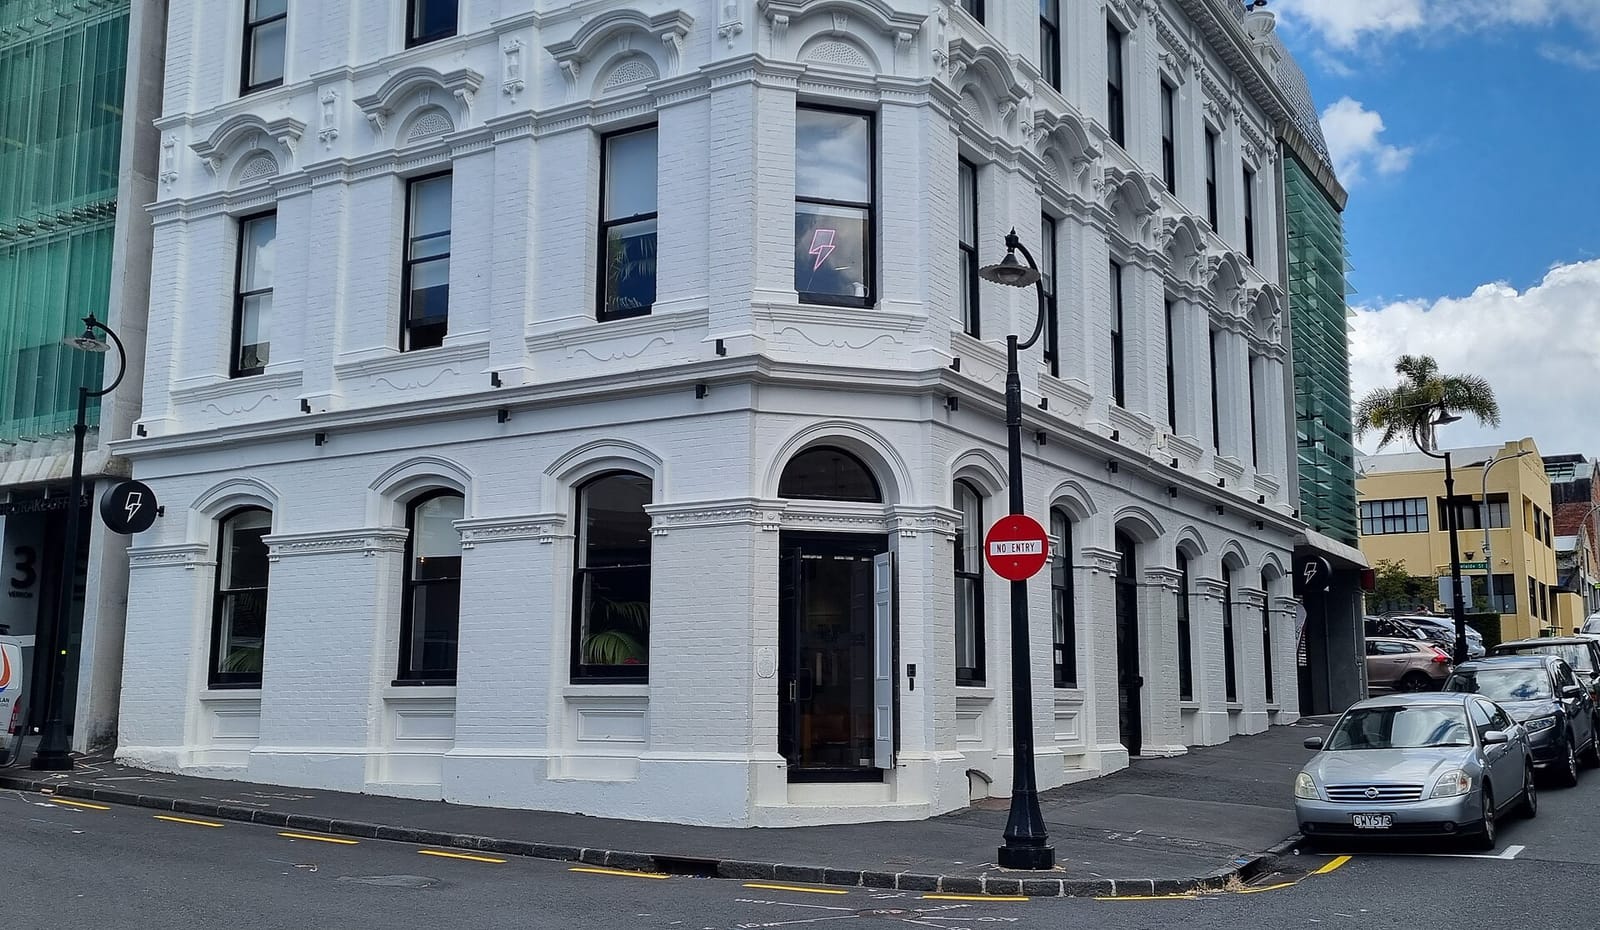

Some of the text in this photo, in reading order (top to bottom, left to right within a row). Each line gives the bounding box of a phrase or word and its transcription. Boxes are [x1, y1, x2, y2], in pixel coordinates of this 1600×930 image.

[996, 542, 1035, 553] NO ENTRY
[11, 545, 37, 588] 3
